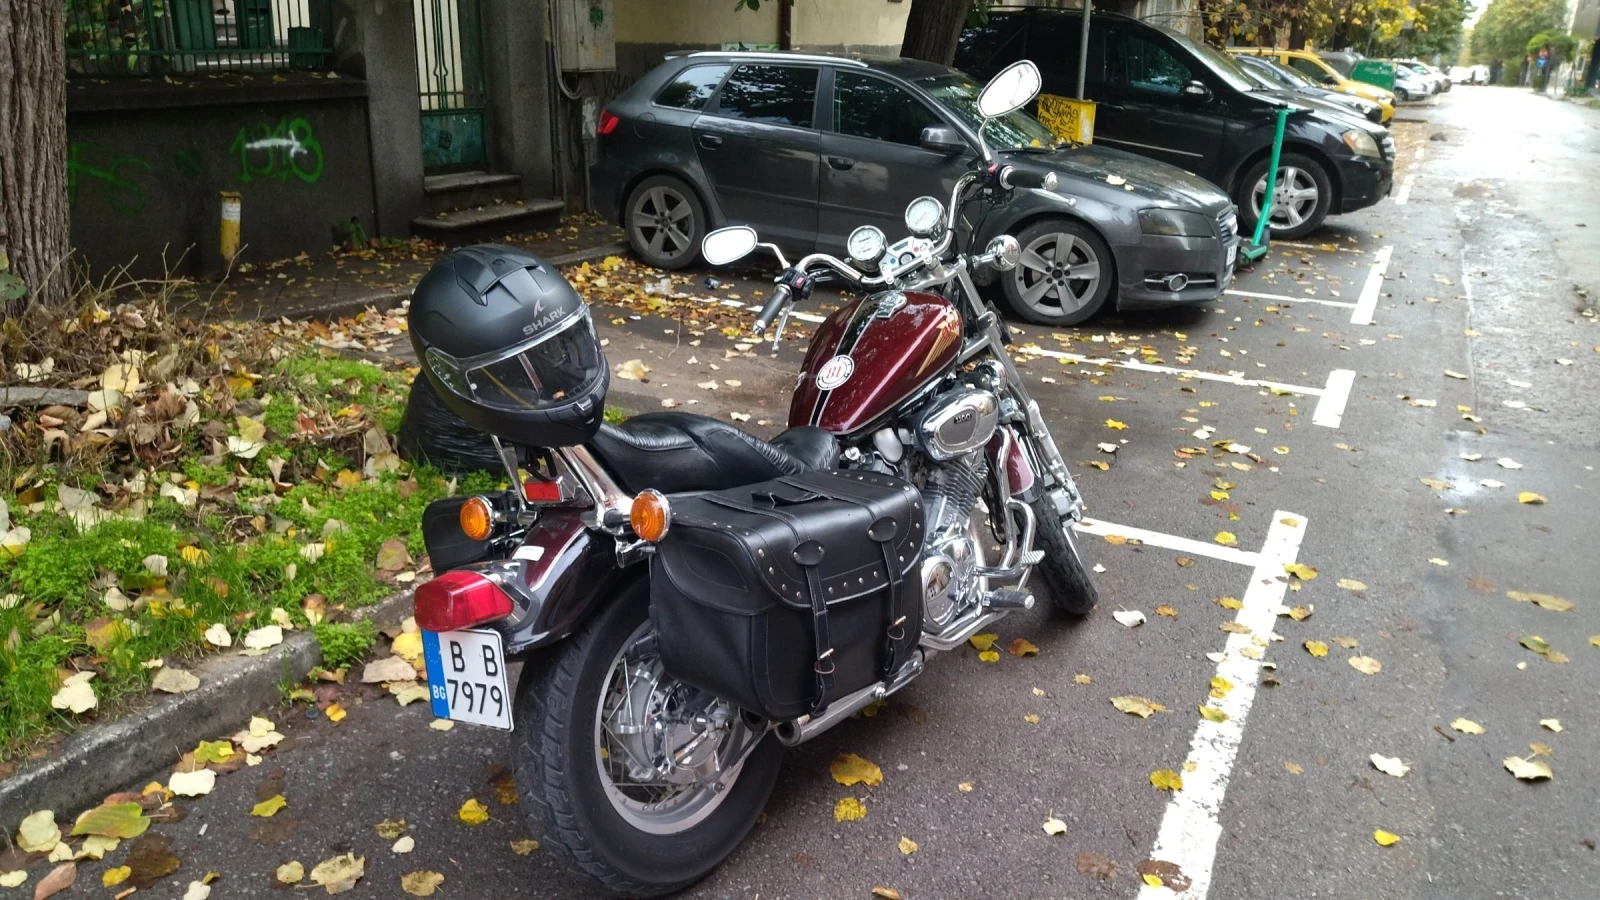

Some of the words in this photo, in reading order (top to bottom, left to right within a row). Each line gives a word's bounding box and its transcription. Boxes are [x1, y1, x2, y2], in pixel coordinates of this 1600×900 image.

[522, 305, 566, 336] SHARK
[450, 640, 465, 672] B
[482, 644, 498, 677] B
[432, 685, 446, 699] BG
[447, 679, 503, 717] 7979
